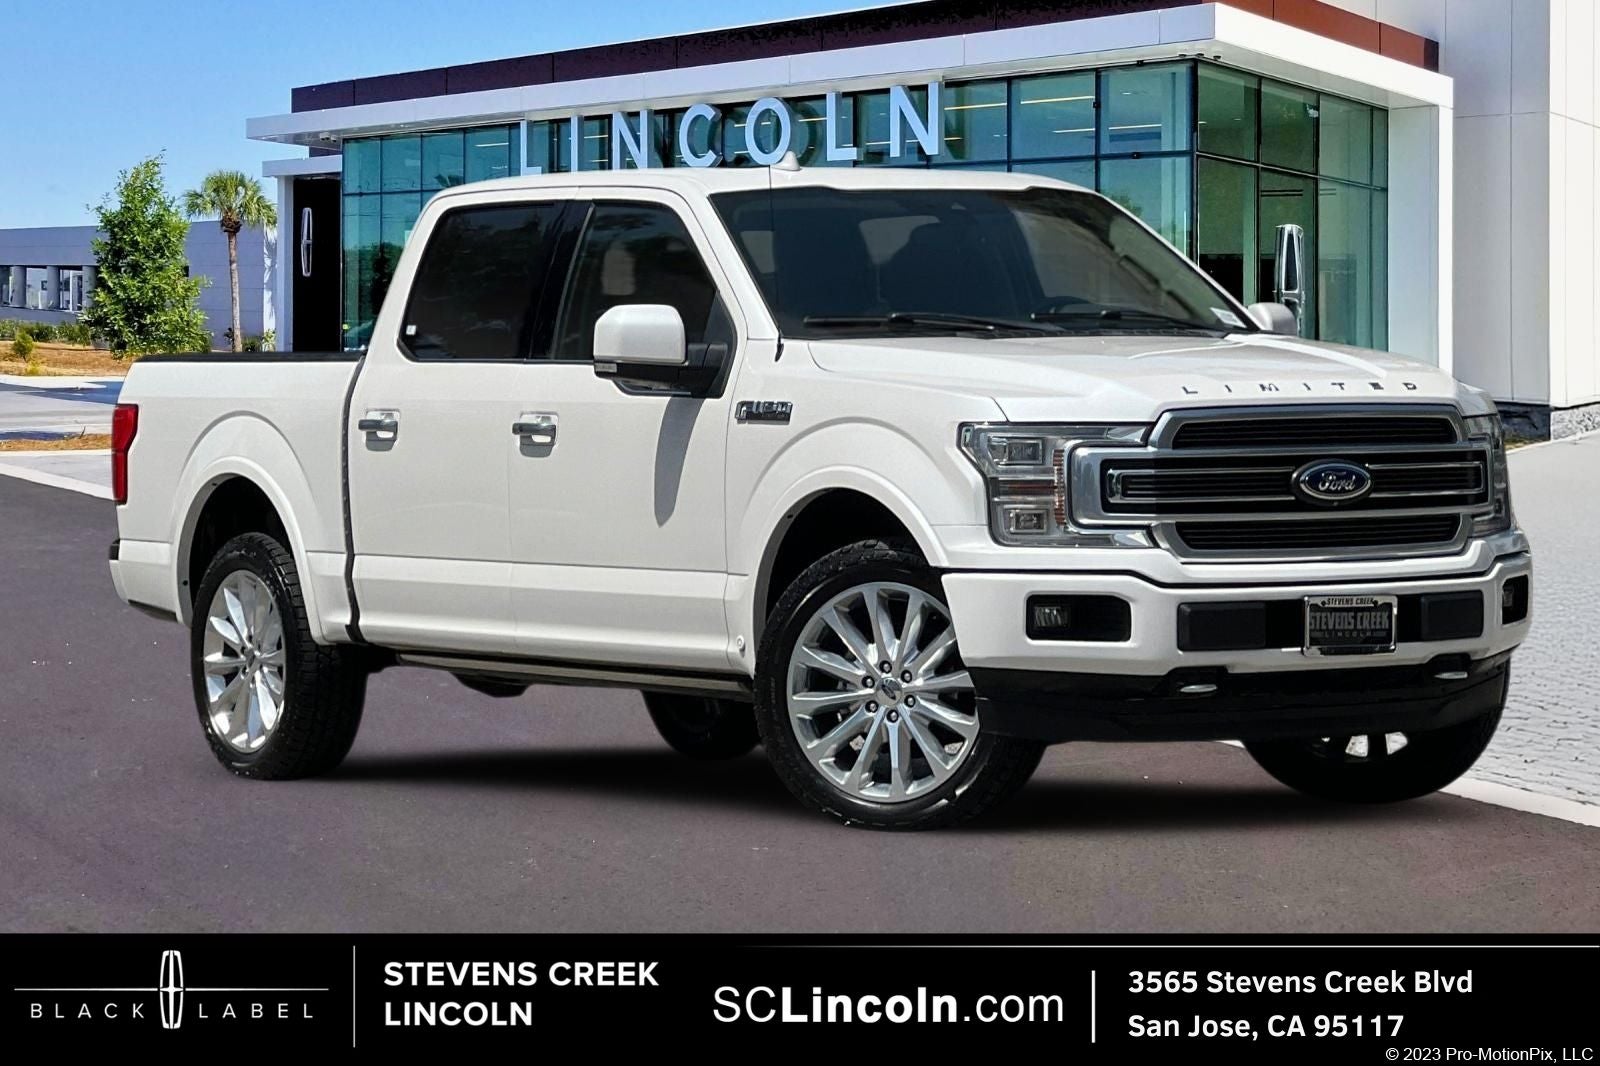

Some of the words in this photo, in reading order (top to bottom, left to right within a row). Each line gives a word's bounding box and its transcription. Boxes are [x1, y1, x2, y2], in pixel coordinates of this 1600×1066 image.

[520, 81, 943, 176] LINCOLN
[1181, 382, 1418, 395] LIMITED
[1317, 471, 1356, 491] Ford
[1310, 612, 1355, 629] STEVENS
[1357, 611, 1389, 629] CREEK
